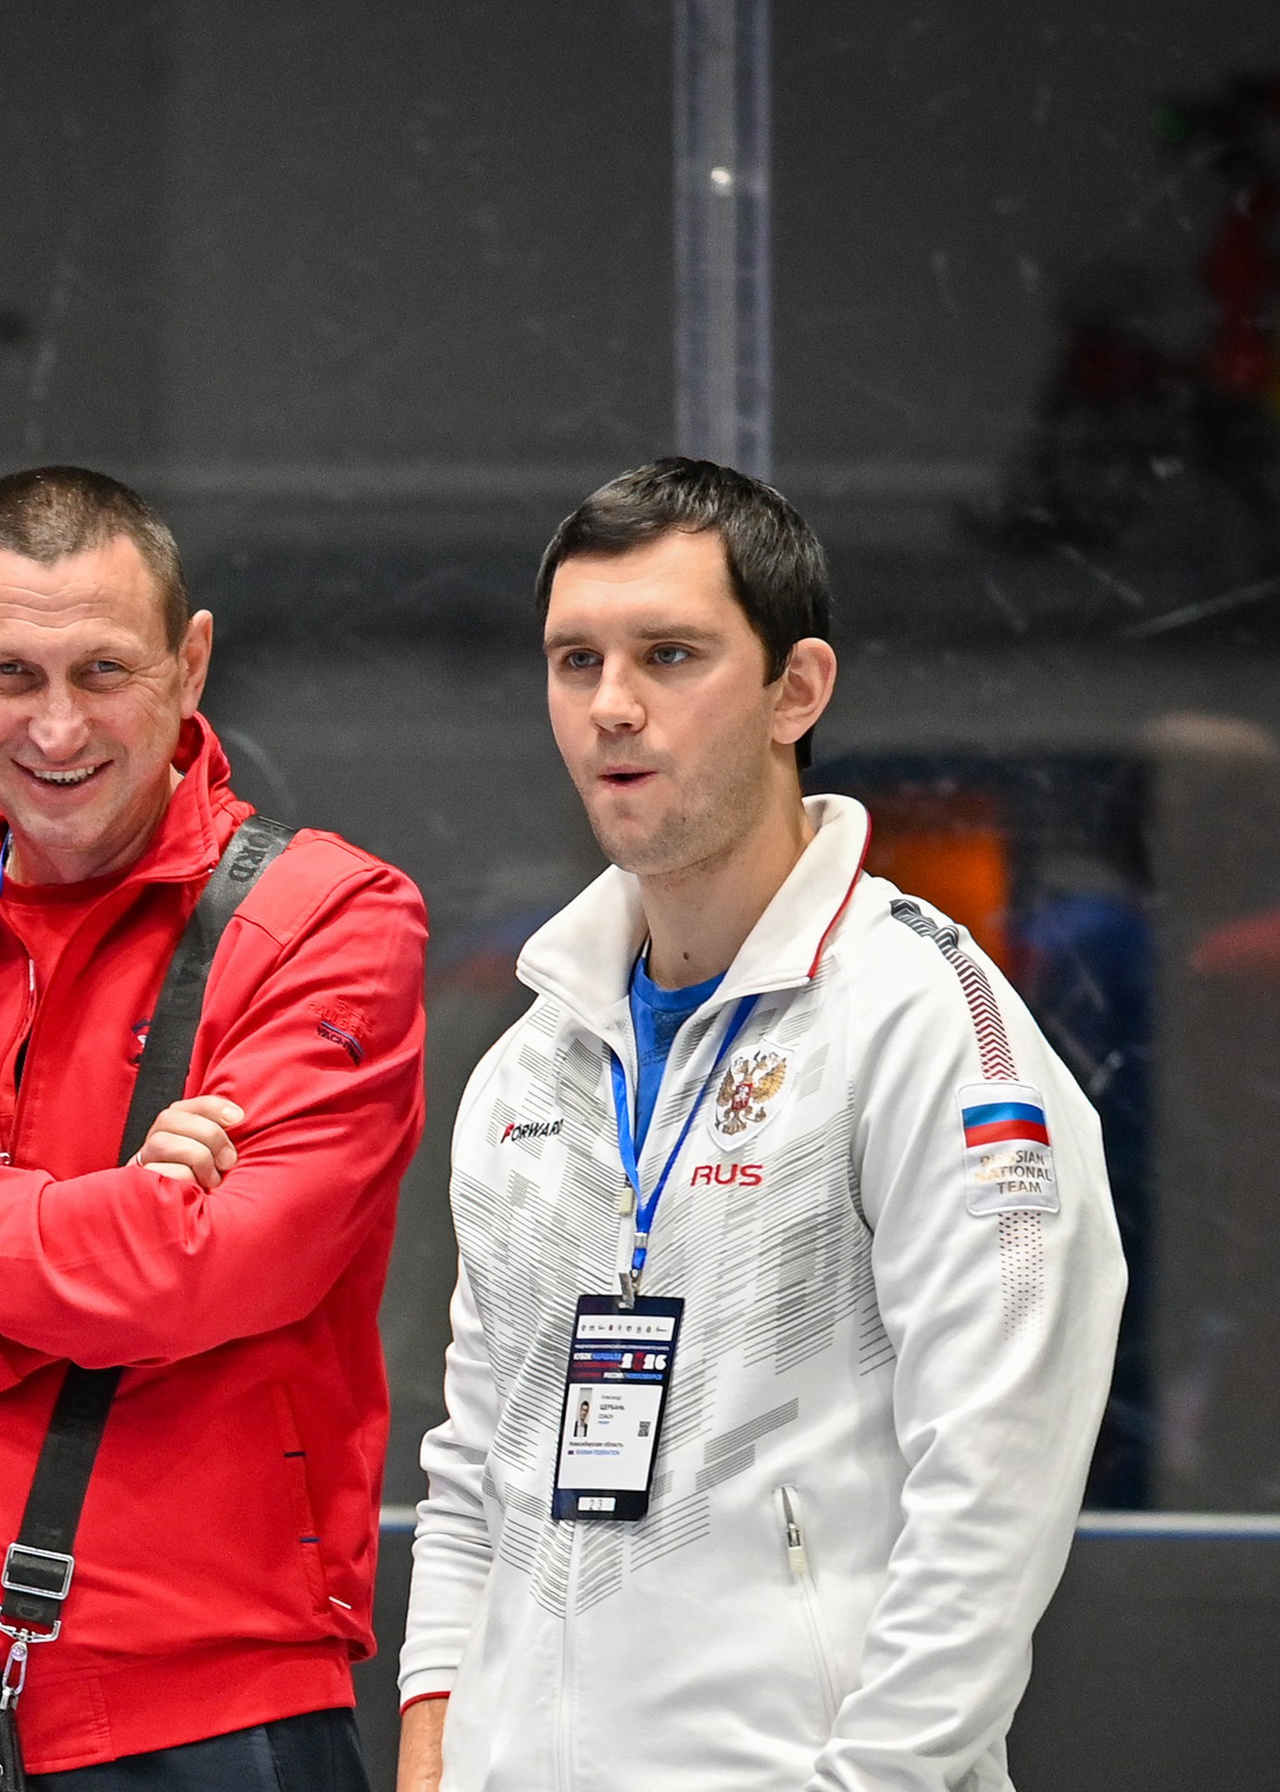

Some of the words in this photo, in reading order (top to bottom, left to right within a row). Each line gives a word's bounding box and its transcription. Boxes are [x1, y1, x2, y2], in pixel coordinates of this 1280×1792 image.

[500, 1118, 564, 1144] FORWAR
[979, 1150, 1045, 1167] RSIAN
[690, 1164, 764, 1187] RUS
[996, 1180, 1042, 1195] TEAM
